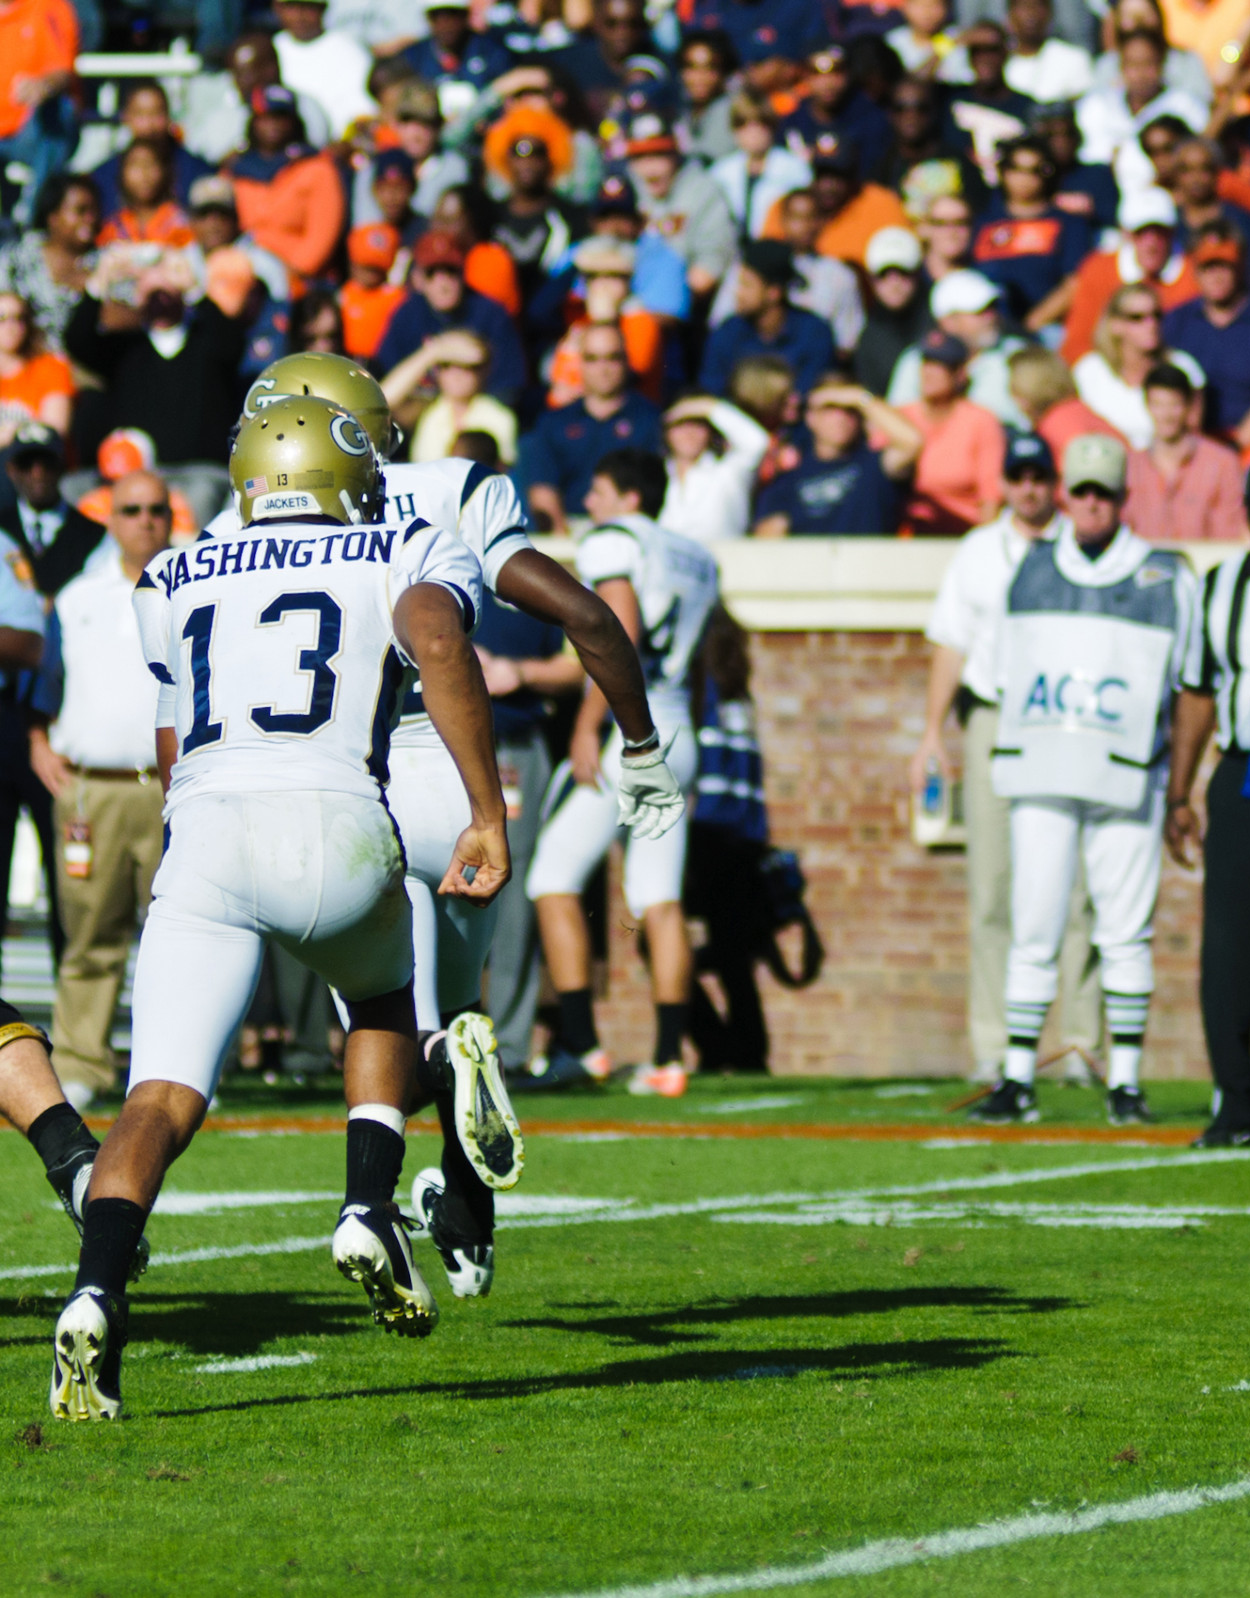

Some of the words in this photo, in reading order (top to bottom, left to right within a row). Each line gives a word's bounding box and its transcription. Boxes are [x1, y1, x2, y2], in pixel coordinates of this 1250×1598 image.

[277, 474, 288, 486] 13
[264, 496, 308, 510] JACKETS
[180, 588, 346, 758] 13
[1021, 672, 1129, 721] ACC
